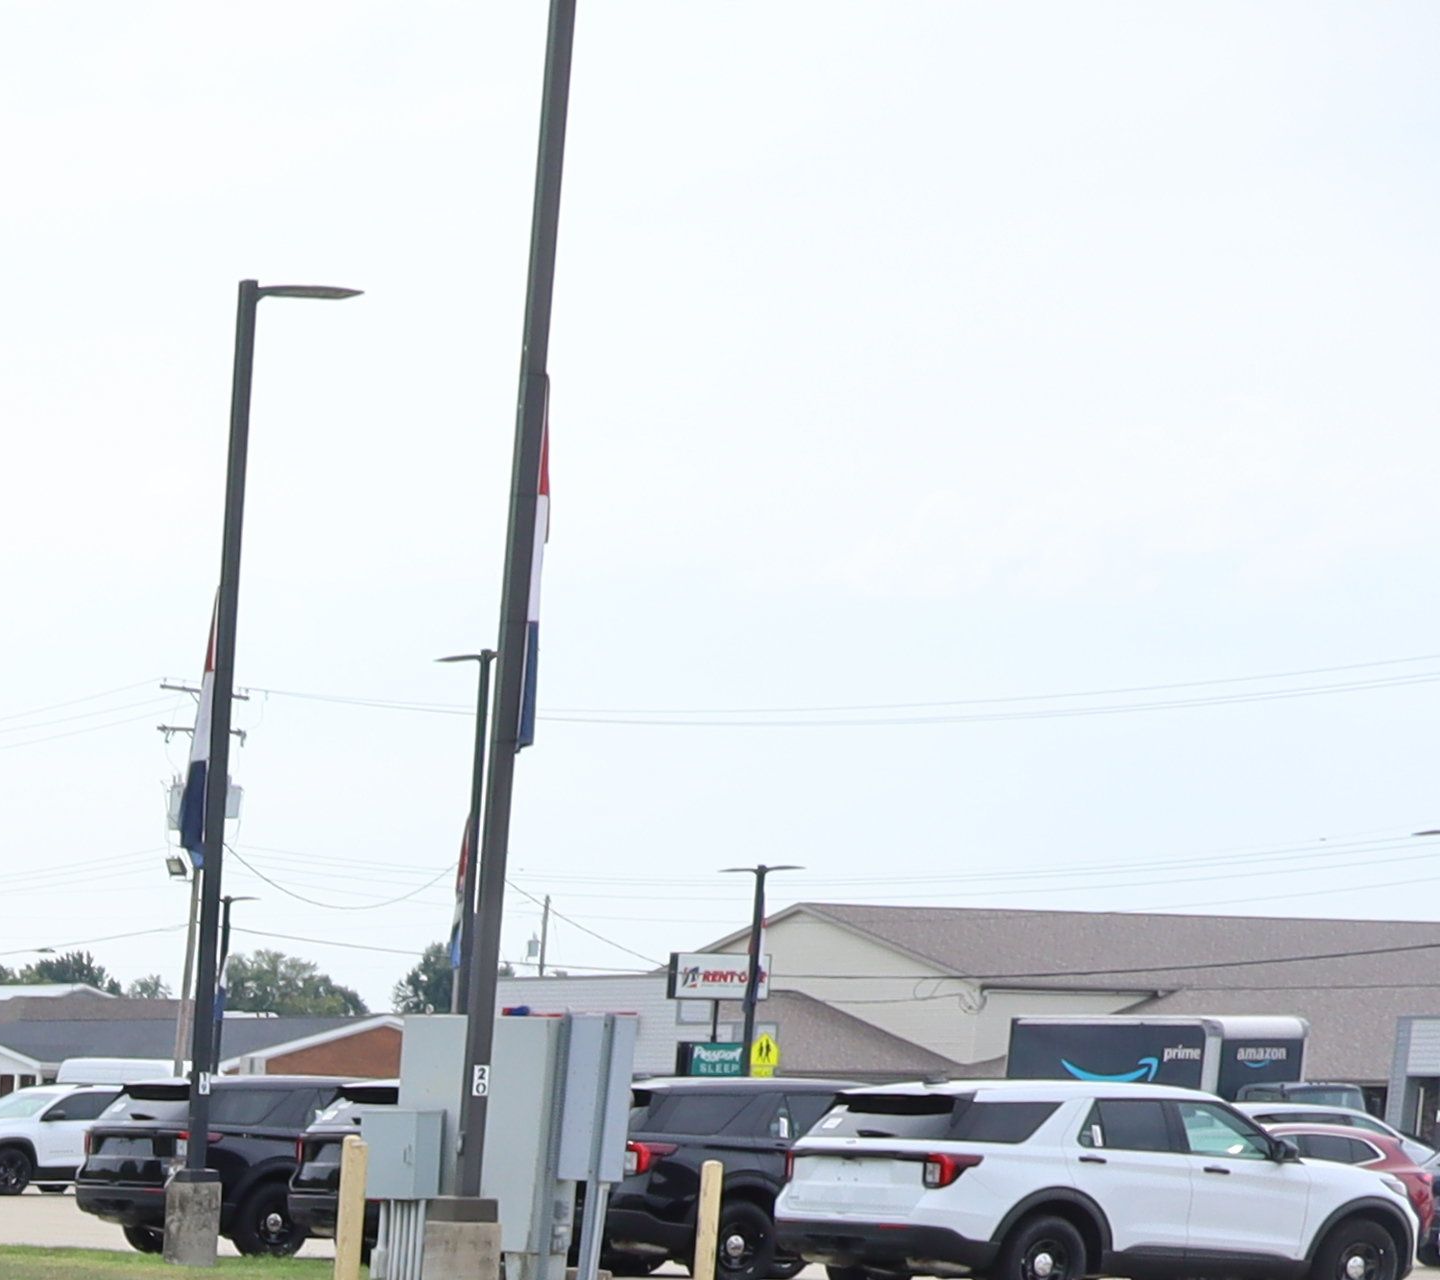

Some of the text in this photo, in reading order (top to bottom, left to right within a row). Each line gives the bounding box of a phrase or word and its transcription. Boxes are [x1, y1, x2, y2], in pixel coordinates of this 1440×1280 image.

[702, 970, 736, 983] RENT
[1163, 1045, 1201, 1062] prime
[1237, 1047, 1287, 1060] amazon
[700, 1064, 740, 1073] SLEEP
[476, 1067, 486, 1094] 20
